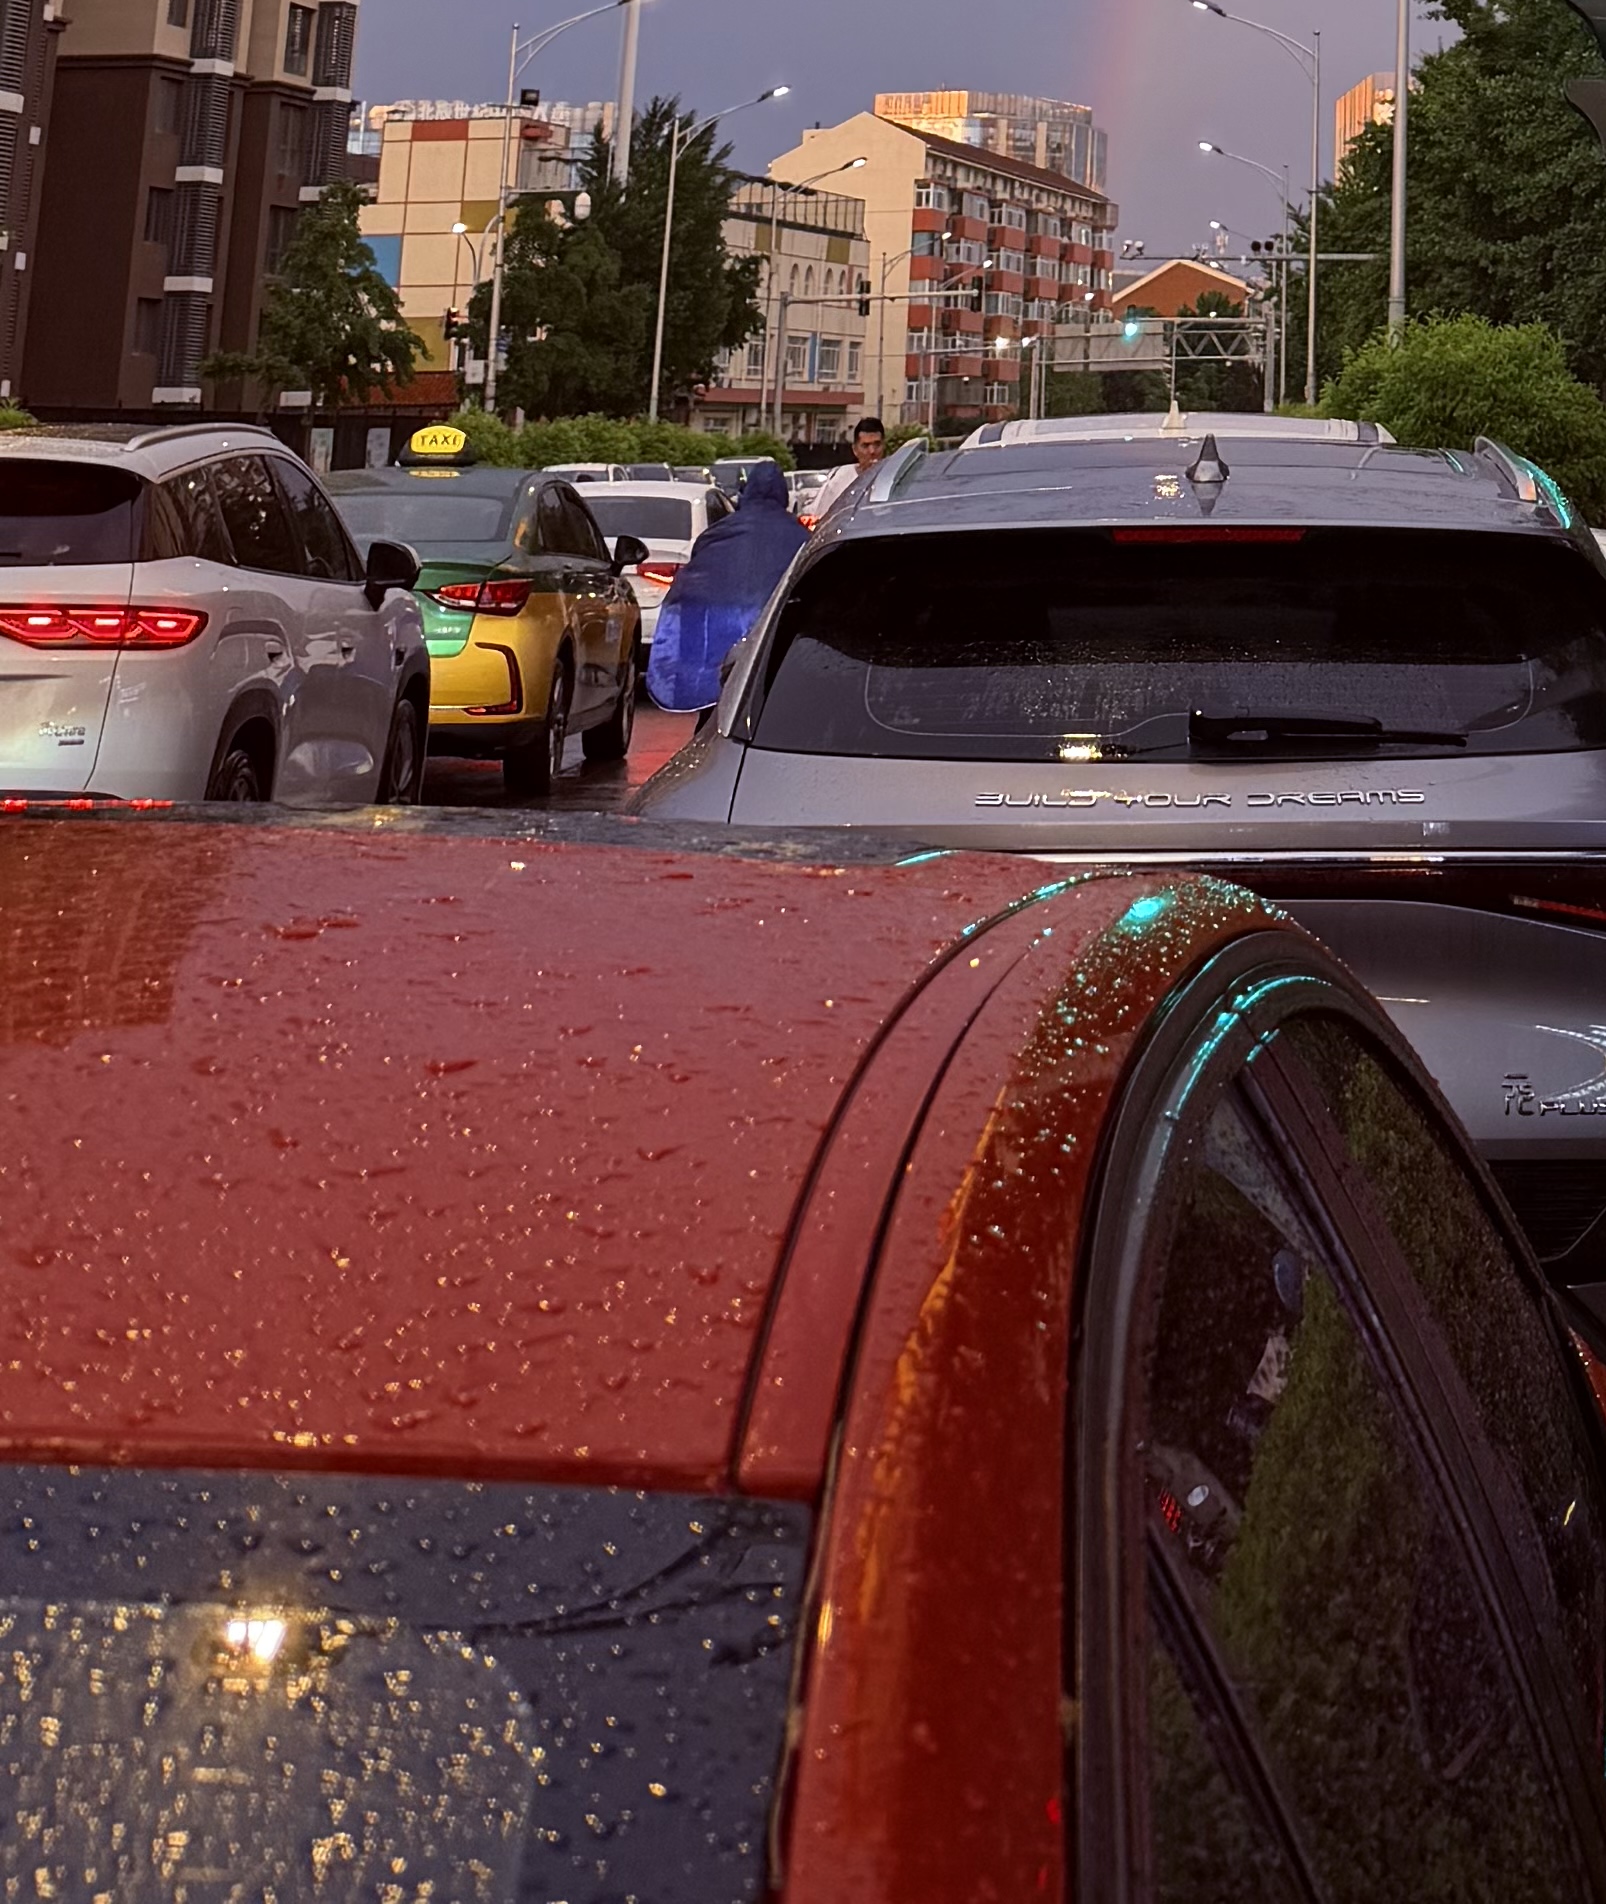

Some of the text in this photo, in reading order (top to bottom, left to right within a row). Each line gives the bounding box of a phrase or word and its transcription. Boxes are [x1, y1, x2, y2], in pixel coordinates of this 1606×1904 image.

[420, 434, 461, 446] TAXI
[975, 789, 1425, 809] BUILD YOUR DREAMS
